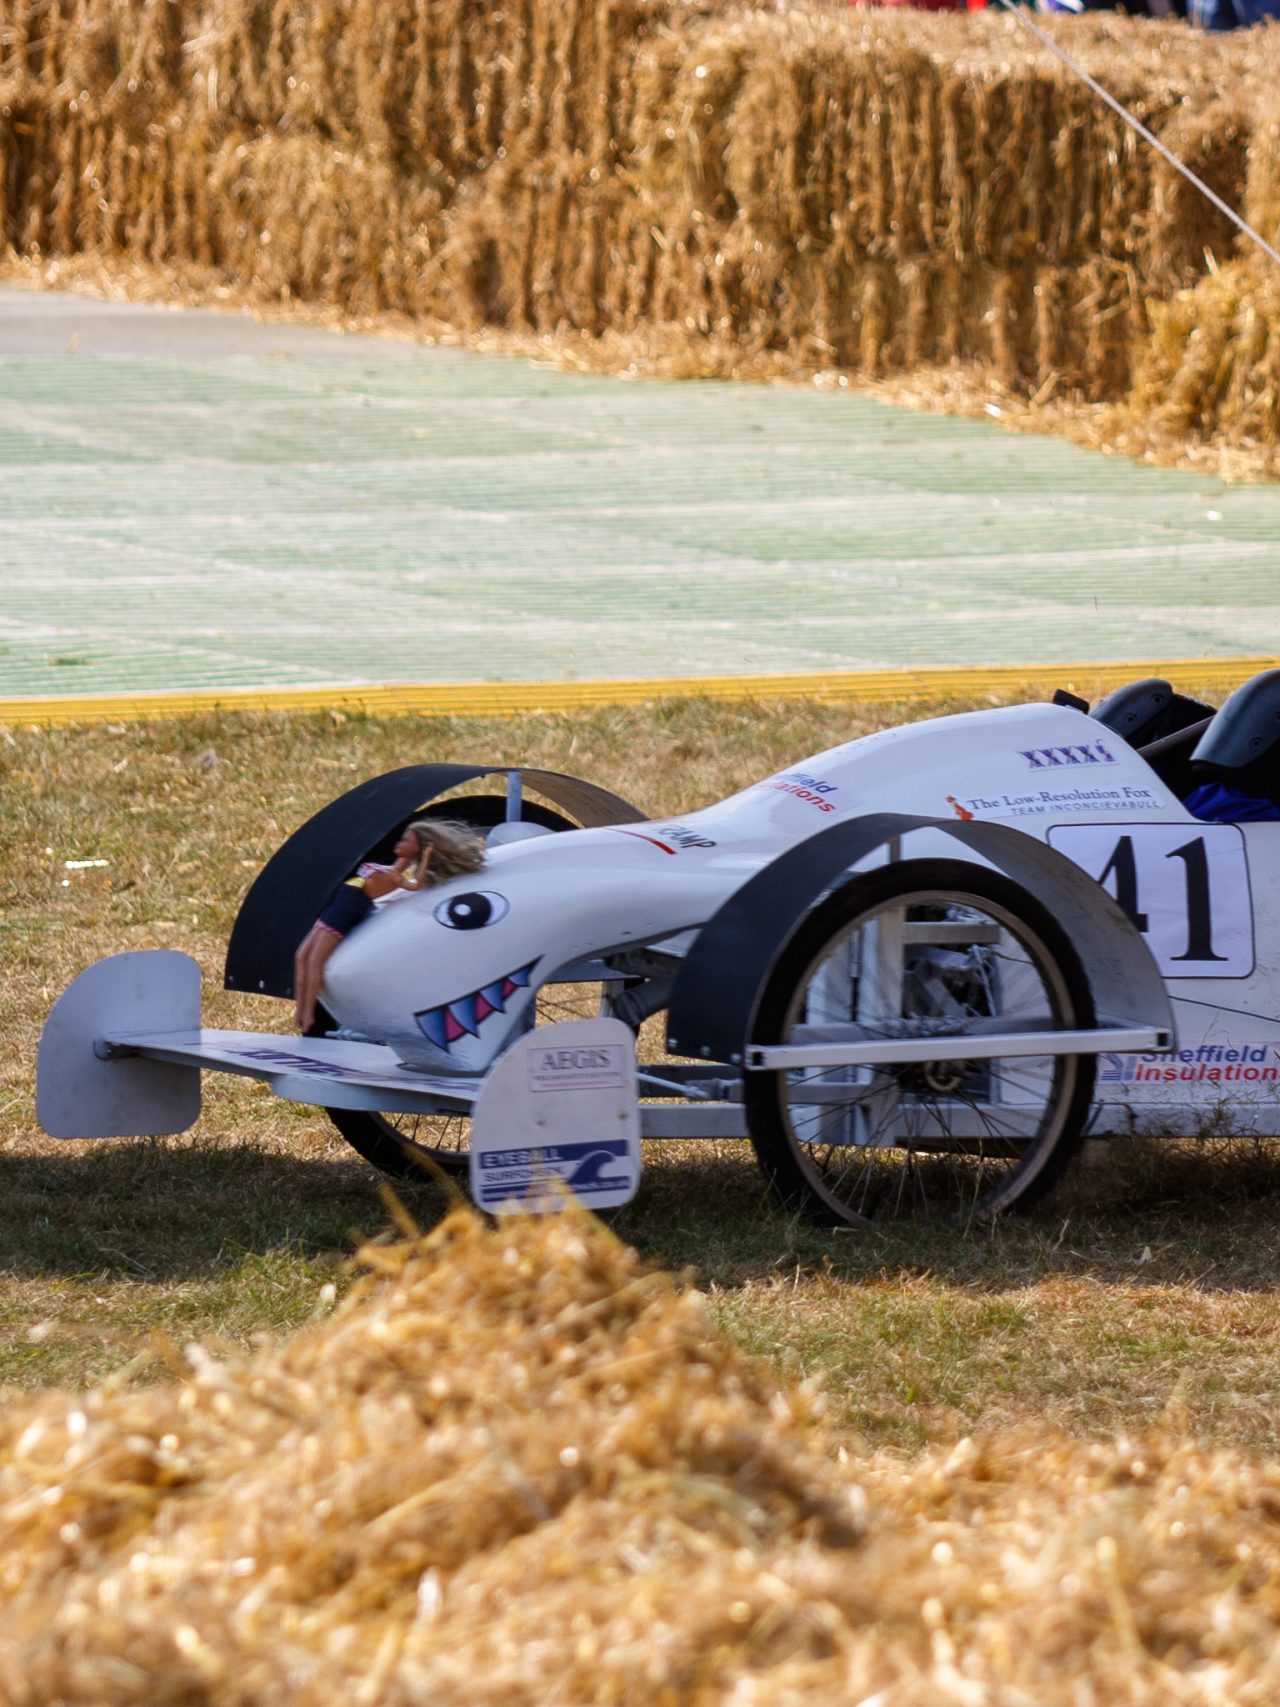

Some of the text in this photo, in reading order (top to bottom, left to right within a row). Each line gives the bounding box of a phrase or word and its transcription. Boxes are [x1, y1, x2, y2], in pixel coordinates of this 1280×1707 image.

[966, 786, 1152, 811] The Low-Resolution Fox
[1010, 805, 1045, 815] TEAM
[1098, 835, 1229, 962] 41
[540, 1048, 611, 1071] AEGIS
